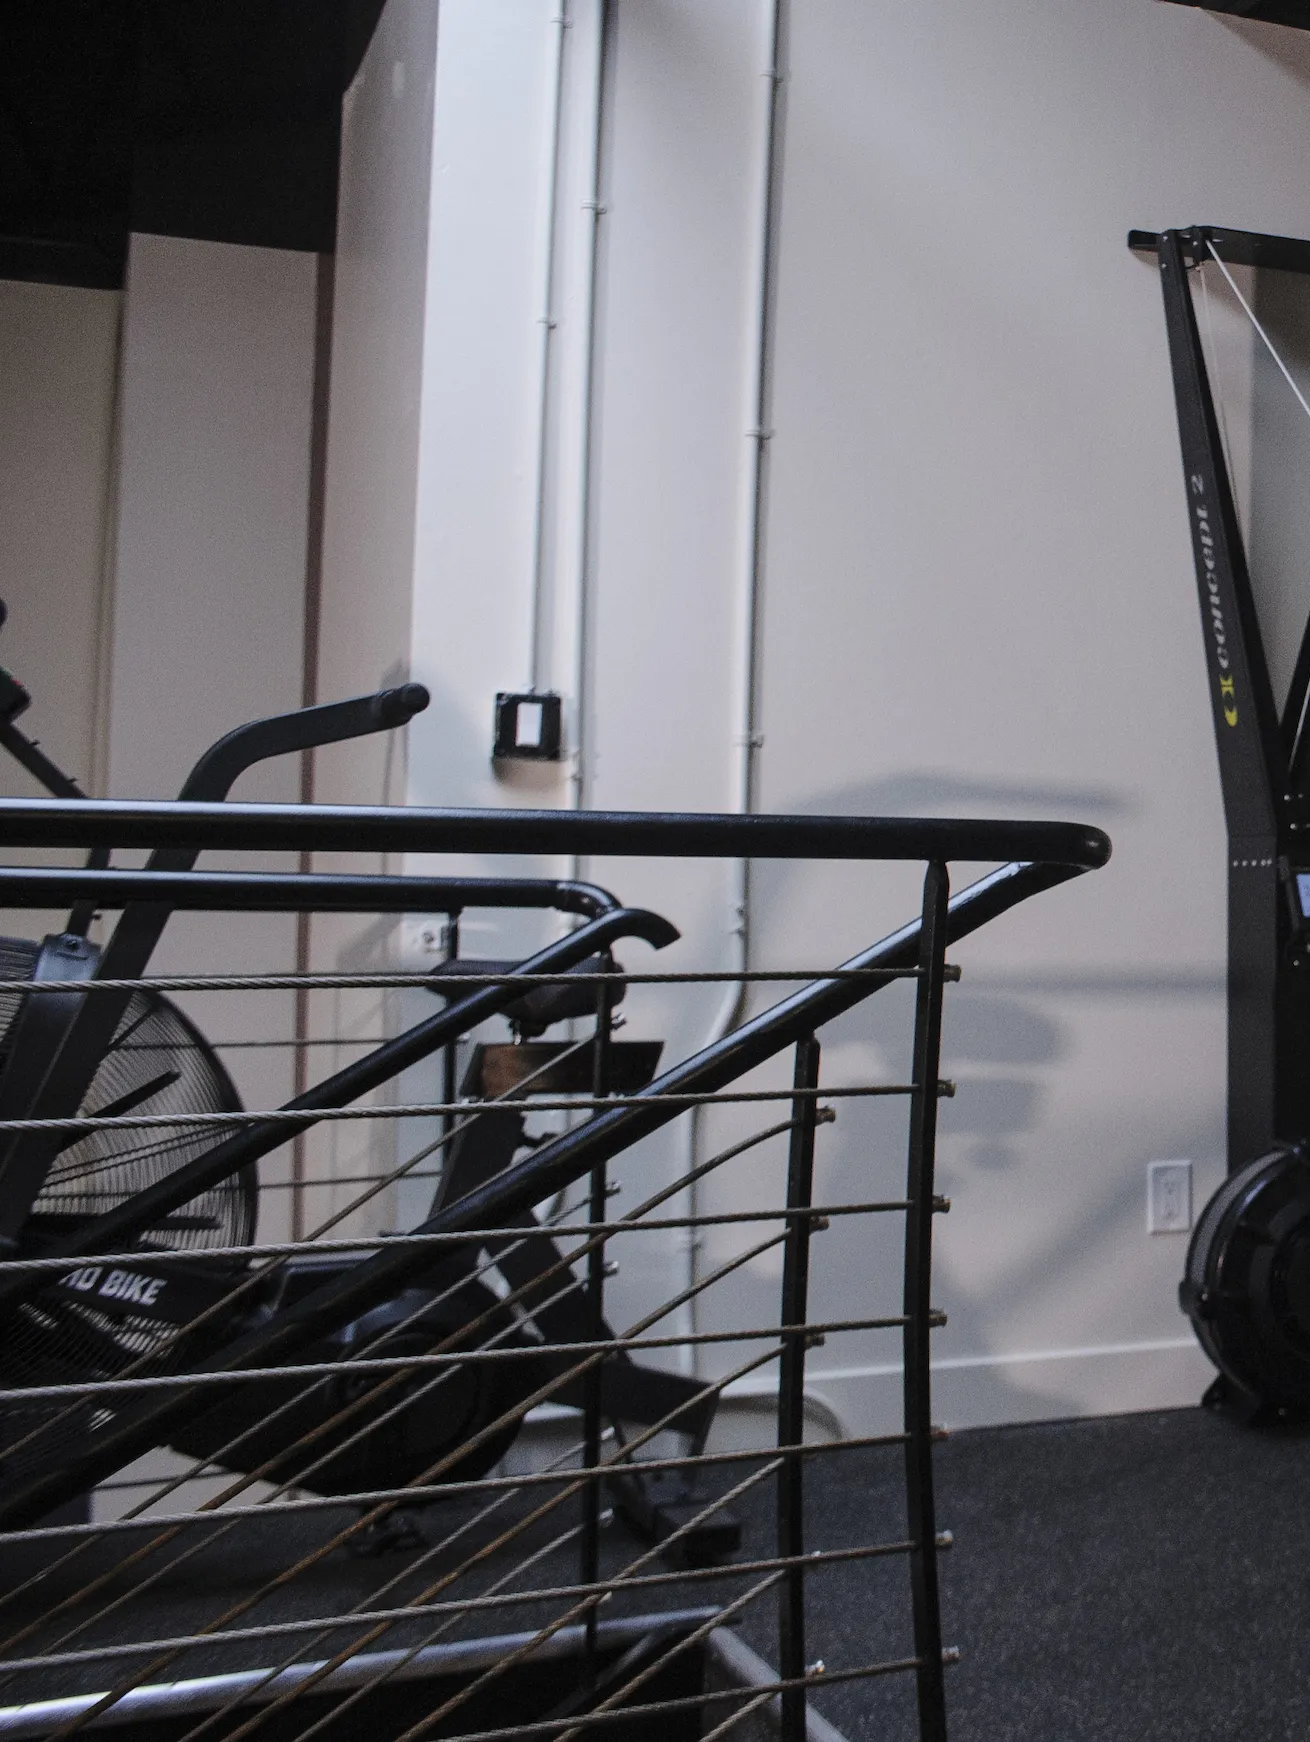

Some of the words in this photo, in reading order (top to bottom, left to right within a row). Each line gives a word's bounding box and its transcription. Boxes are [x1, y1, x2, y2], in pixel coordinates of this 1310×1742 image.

[1191, 475, 1204, 495] 2
[1196, 505, 1229, 669] concept
[98, 1269, 167, 1305] BIKE
